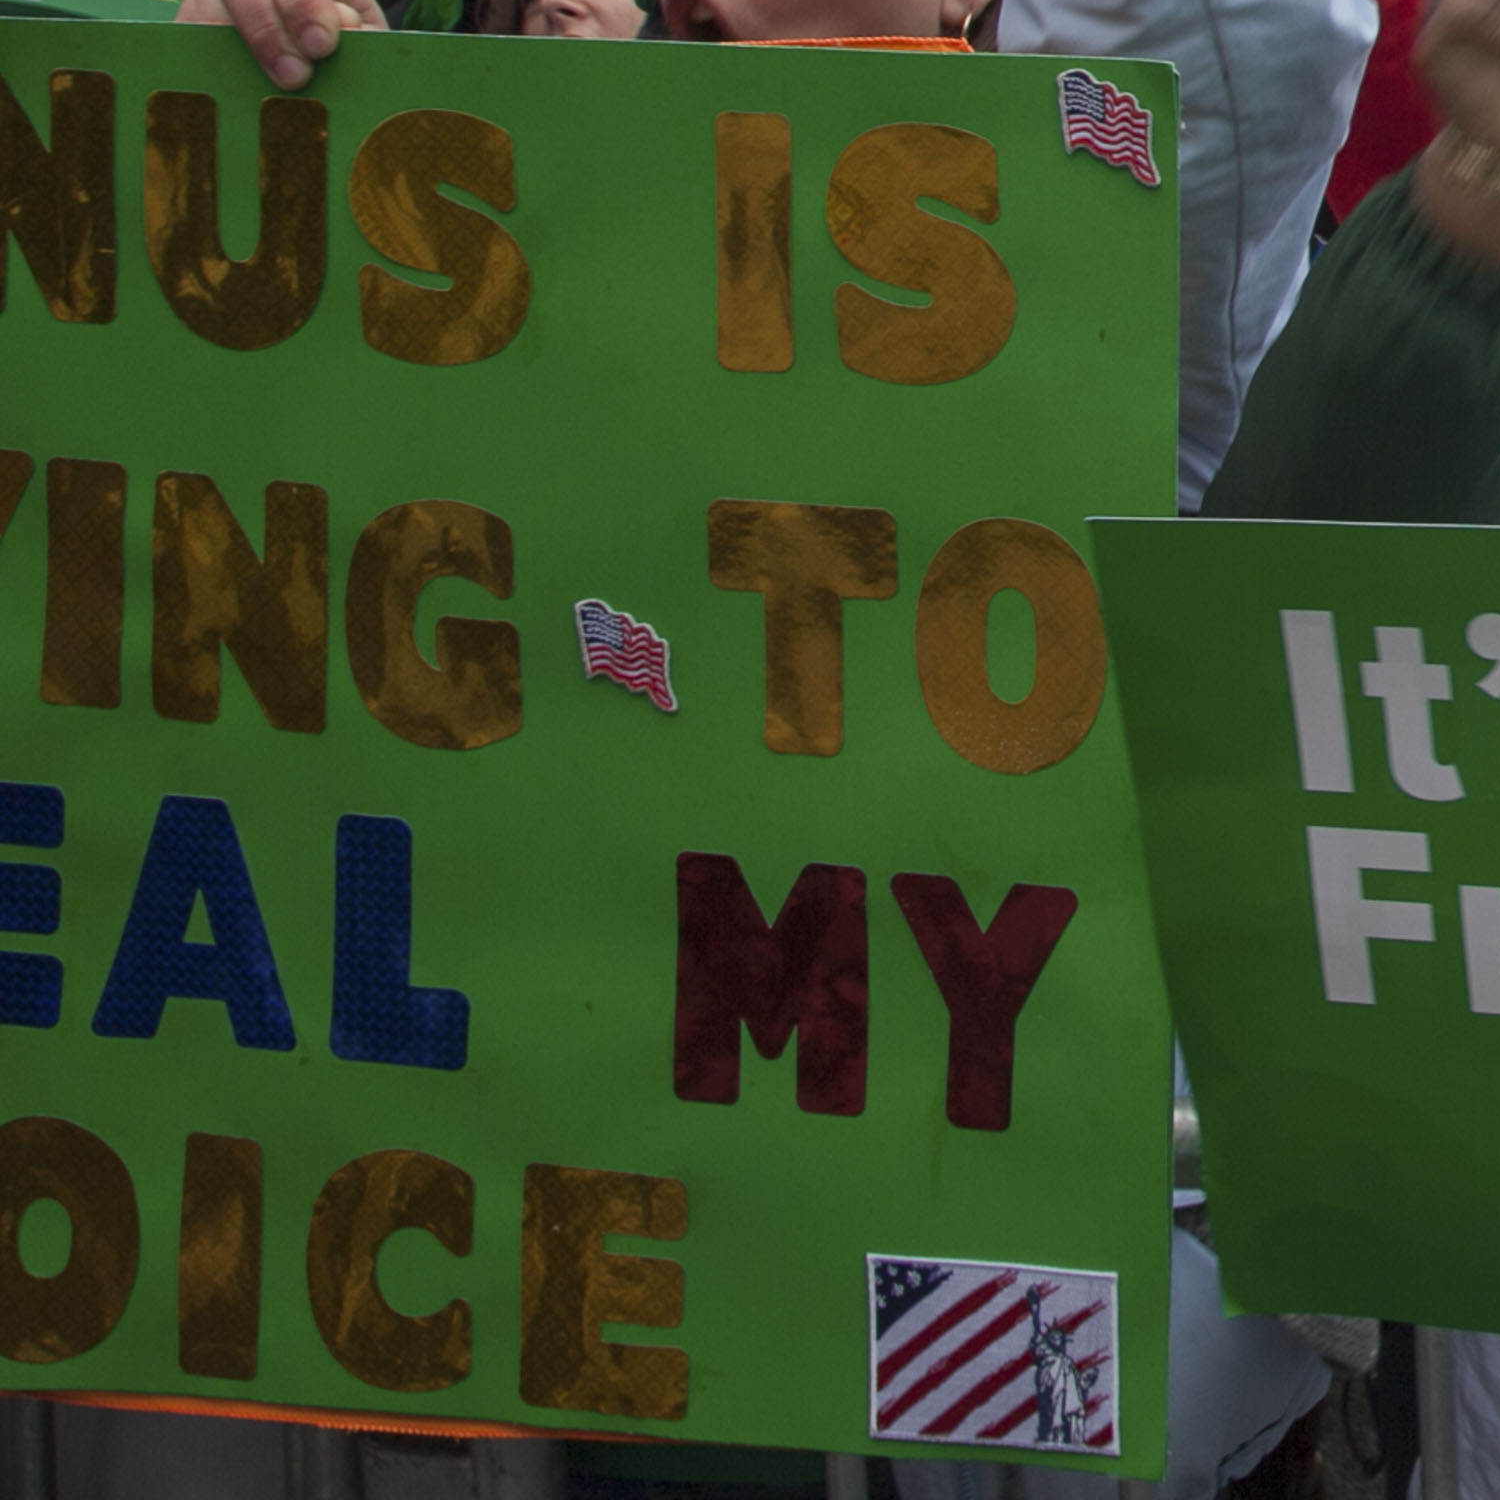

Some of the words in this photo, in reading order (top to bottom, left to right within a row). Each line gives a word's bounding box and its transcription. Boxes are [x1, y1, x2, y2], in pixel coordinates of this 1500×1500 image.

[714, 111, 1017, 386] IS
[0, 448, 523, 752] ING
[707, 499, 1108, 776] TO
[673, 850, 1079, 1132] MY
